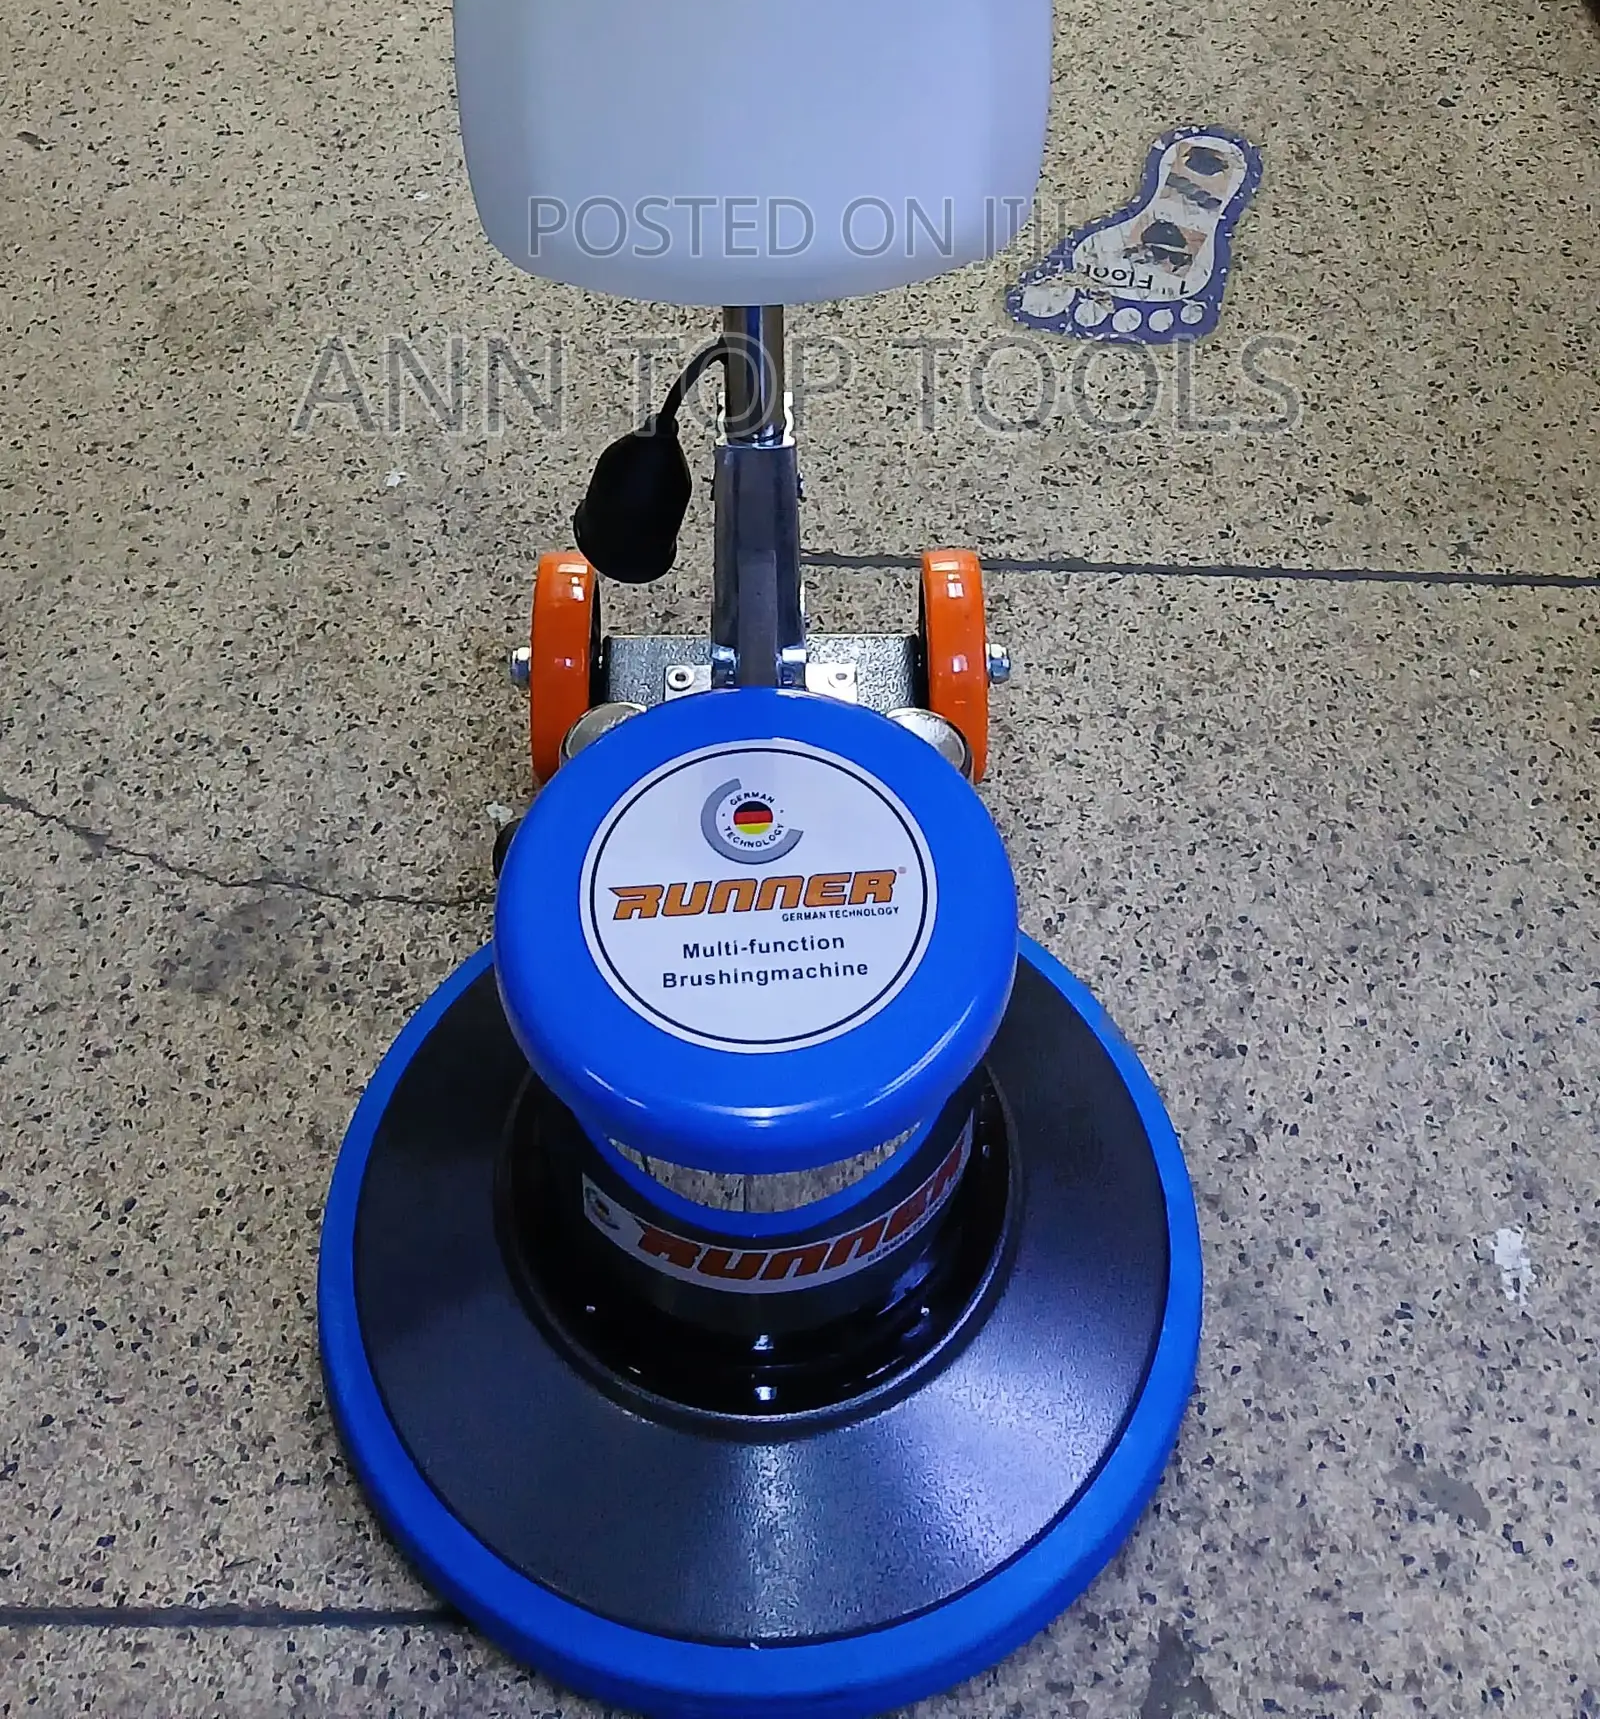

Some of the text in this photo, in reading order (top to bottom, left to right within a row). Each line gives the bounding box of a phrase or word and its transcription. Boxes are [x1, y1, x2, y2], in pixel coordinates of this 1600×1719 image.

[1085, 264, 1153, 289] Floor
[729, 791, 775, 806] GERMAN
[723, 822, 785, 848] TECHNOLOGY
[608, 869, 897, 920] RUNNER
[781, 906, 899, 922] GERMAN TECHNOLOGY
[682, 934, 846, 960] Multi-function
[662, 962, 869, 989] Brushingmachine
